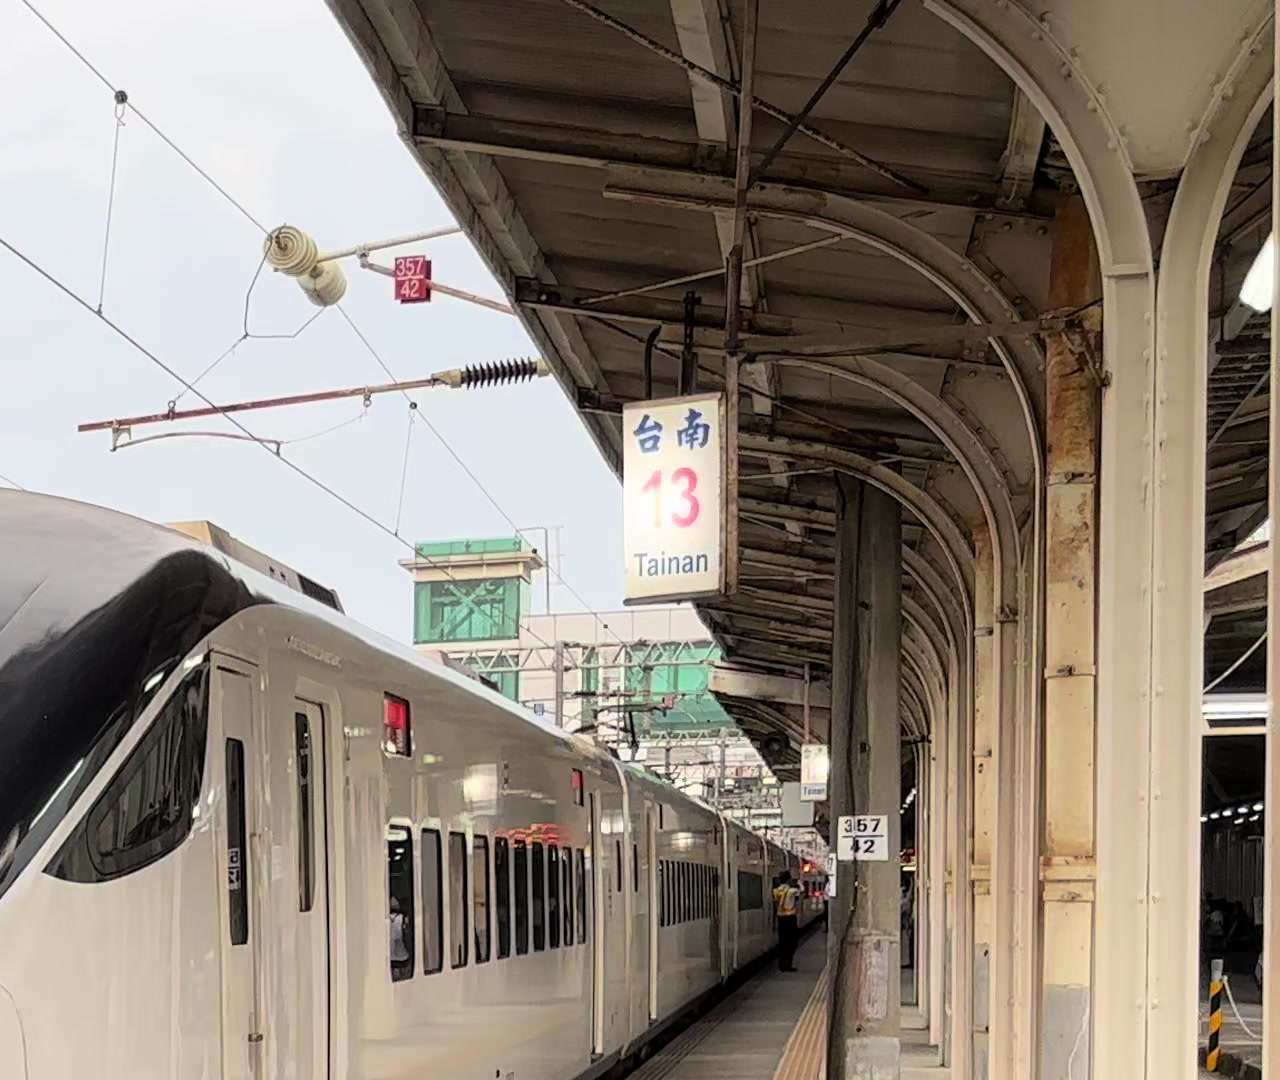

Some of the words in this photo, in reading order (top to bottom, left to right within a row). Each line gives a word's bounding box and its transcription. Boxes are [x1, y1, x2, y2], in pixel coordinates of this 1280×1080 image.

[396, 258, 424, 276] 357
[400, 280, 420, 298] 42
[633, 408, 710, 453] 台南
[642, 467, 700, 527] 13
[634, 552, 708, 576] Tainan
[844, 818, 881, 833] 357
[850, 838, 876, 853] 42
